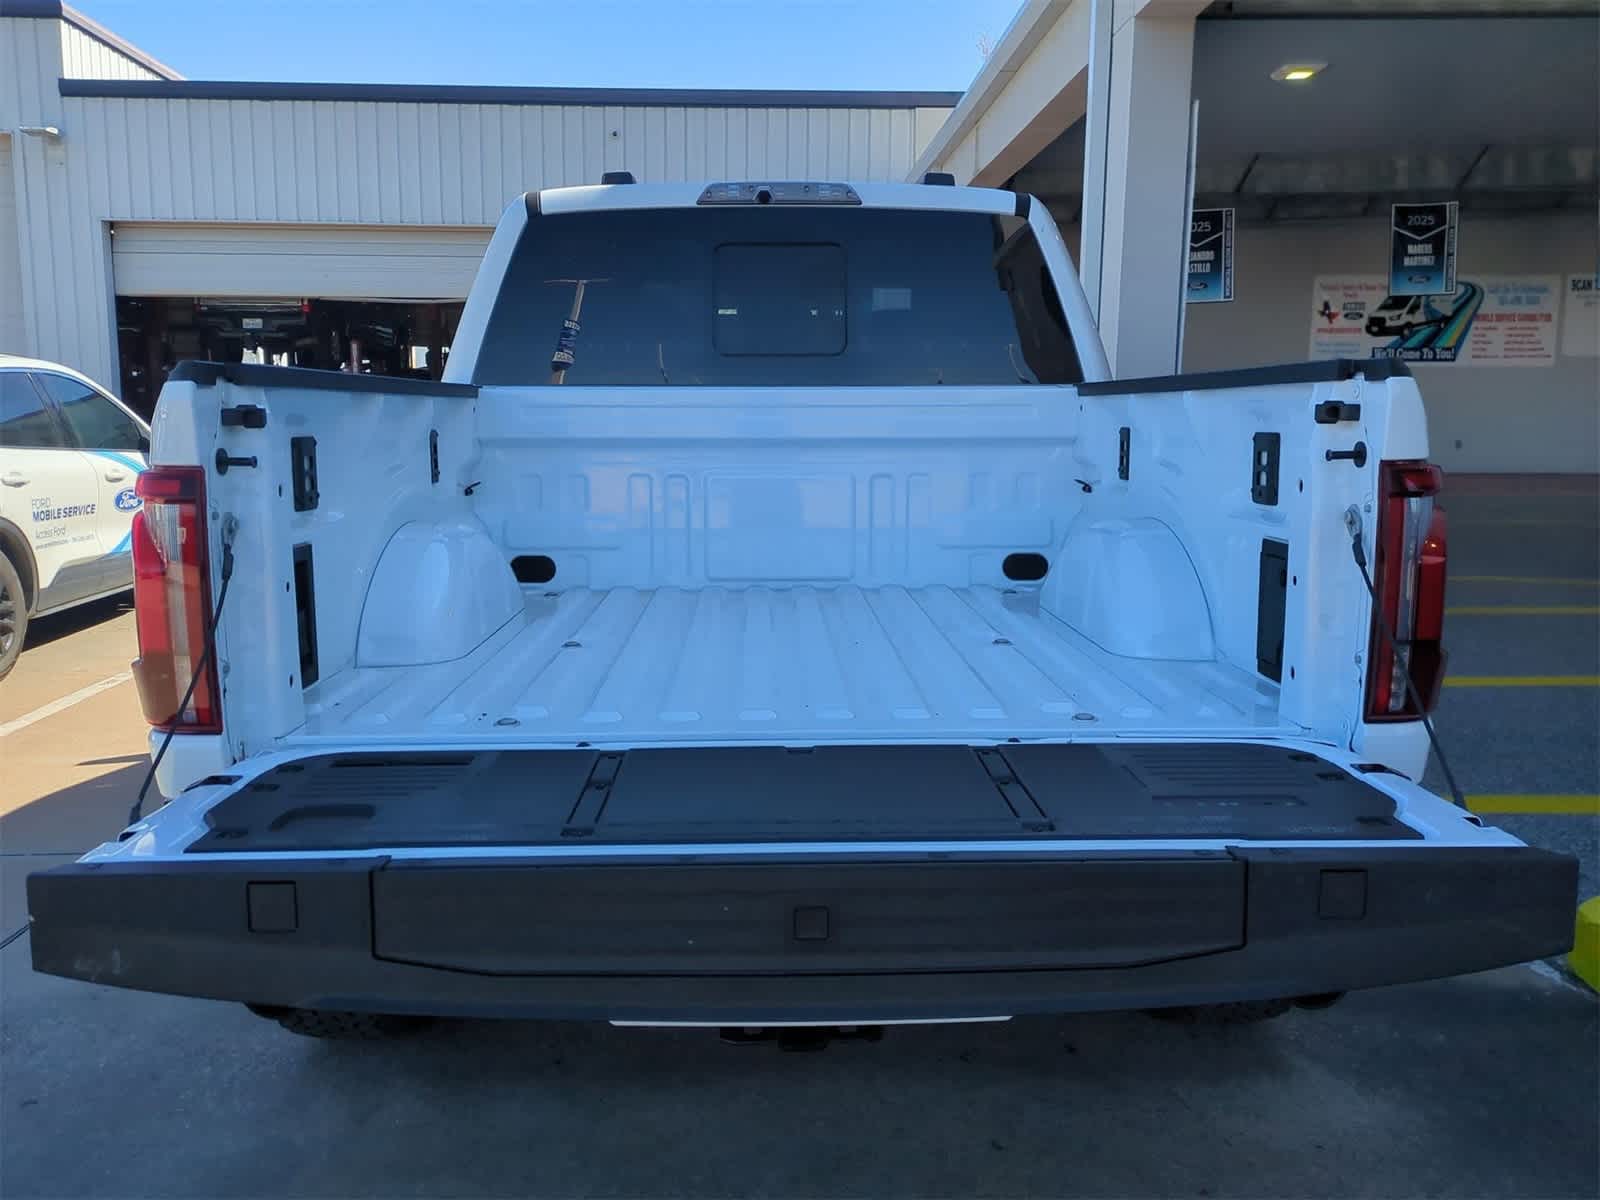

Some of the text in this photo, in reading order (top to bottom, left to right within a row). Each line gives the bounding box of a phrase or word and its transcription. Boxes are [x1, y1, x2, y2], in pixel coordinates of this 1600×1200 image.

[1408, 215, 1434, 226] 2025
[1191, 221, 1212, 233] 025
[1571, 279, 1592, 291] SCAN
[1374, 348, 1395, 359] We'll
[1397, 348, 1420, 359] Come
[1422, 348, 1433, 359] To
[1436, 348, 1455, 359] You!
[32, 498, 52, 509] FORD
[32, 504, 96, 522] MOBILE SERVICE
